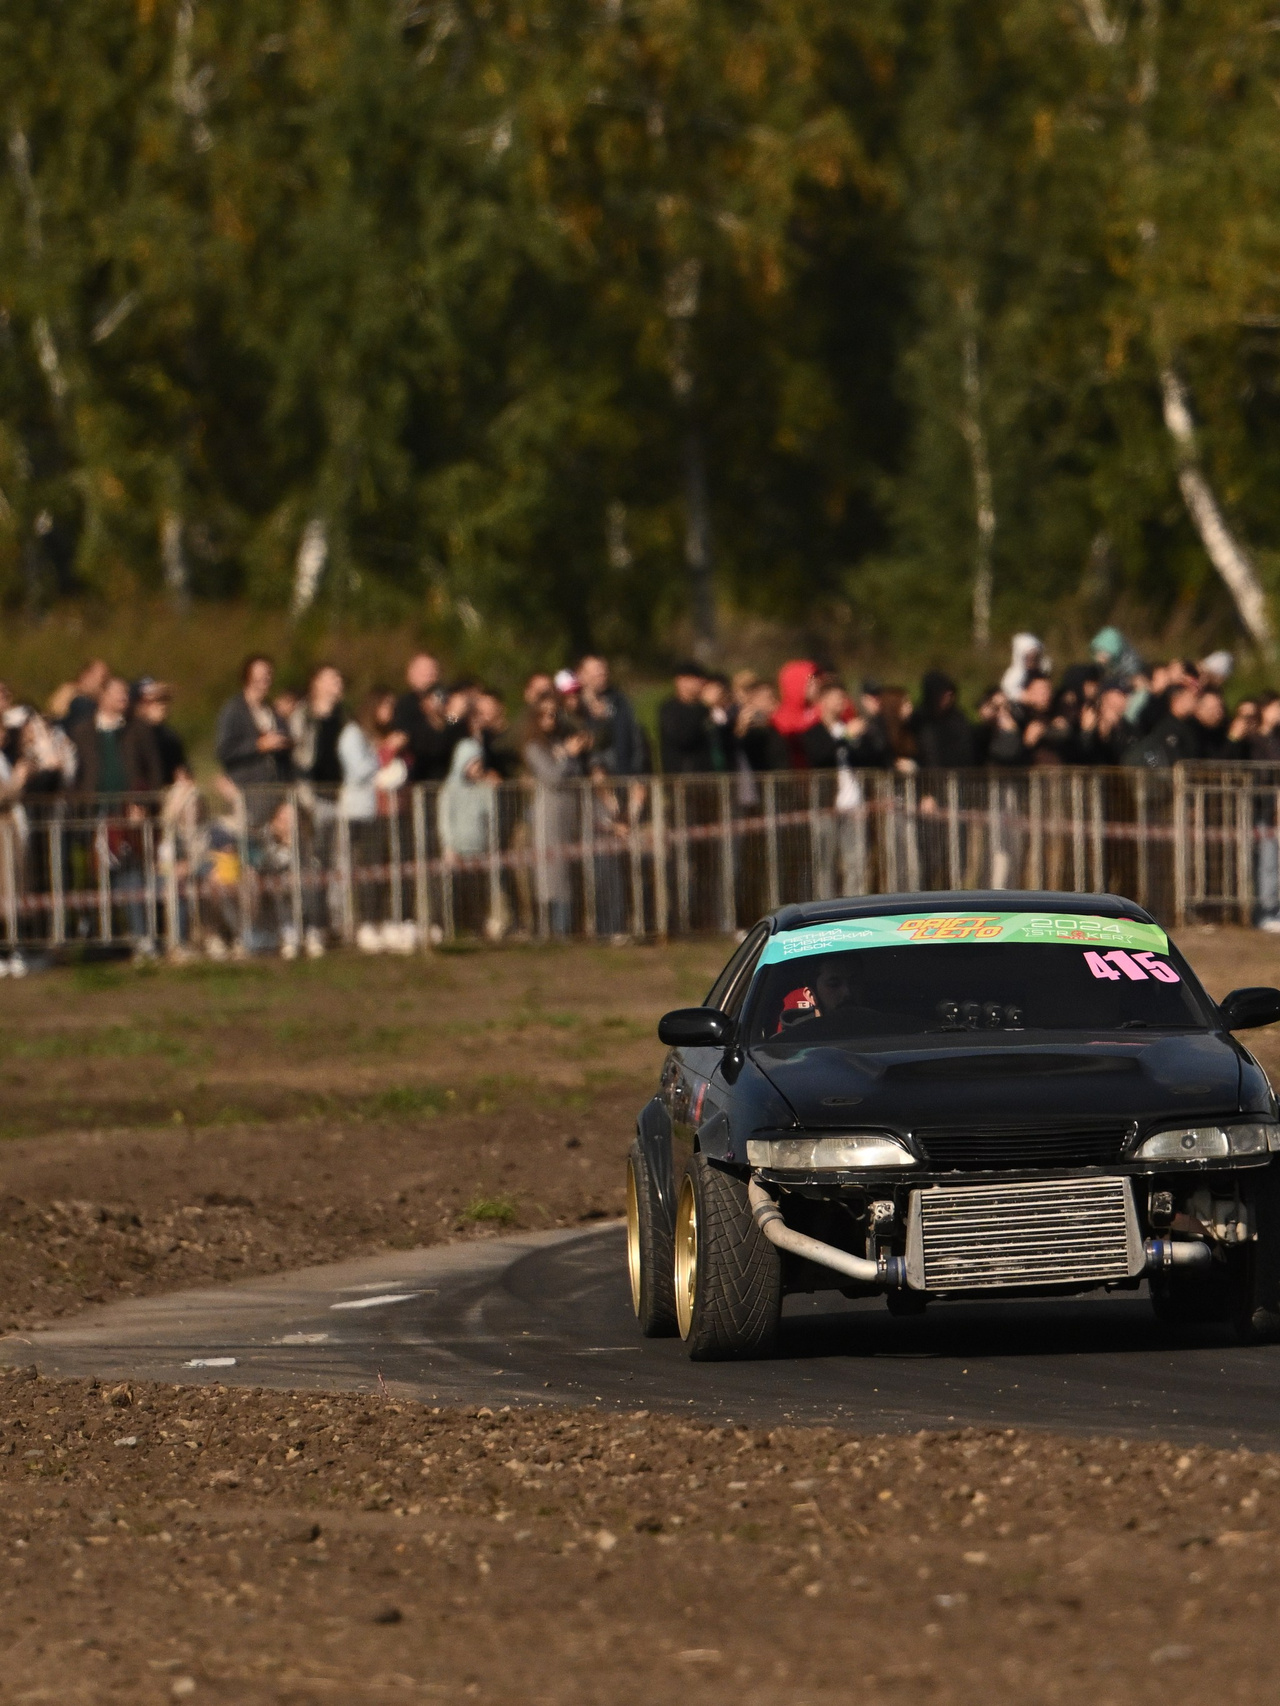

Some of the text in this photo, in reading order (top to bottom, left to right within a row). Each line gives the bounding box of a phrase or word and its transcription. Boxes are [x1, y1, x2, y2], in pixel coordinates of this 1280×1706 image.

[897, 917, 1000, 931] DRIFT
[1030, 918, 1121, 933] 2024
[910, 926, 1003, 940] LETO
[783, 930, 873, 951] СИБИРСКИЙ
[783, 942, 833, 956] КУБОК
[1083, 950, 1181, 983] 415
